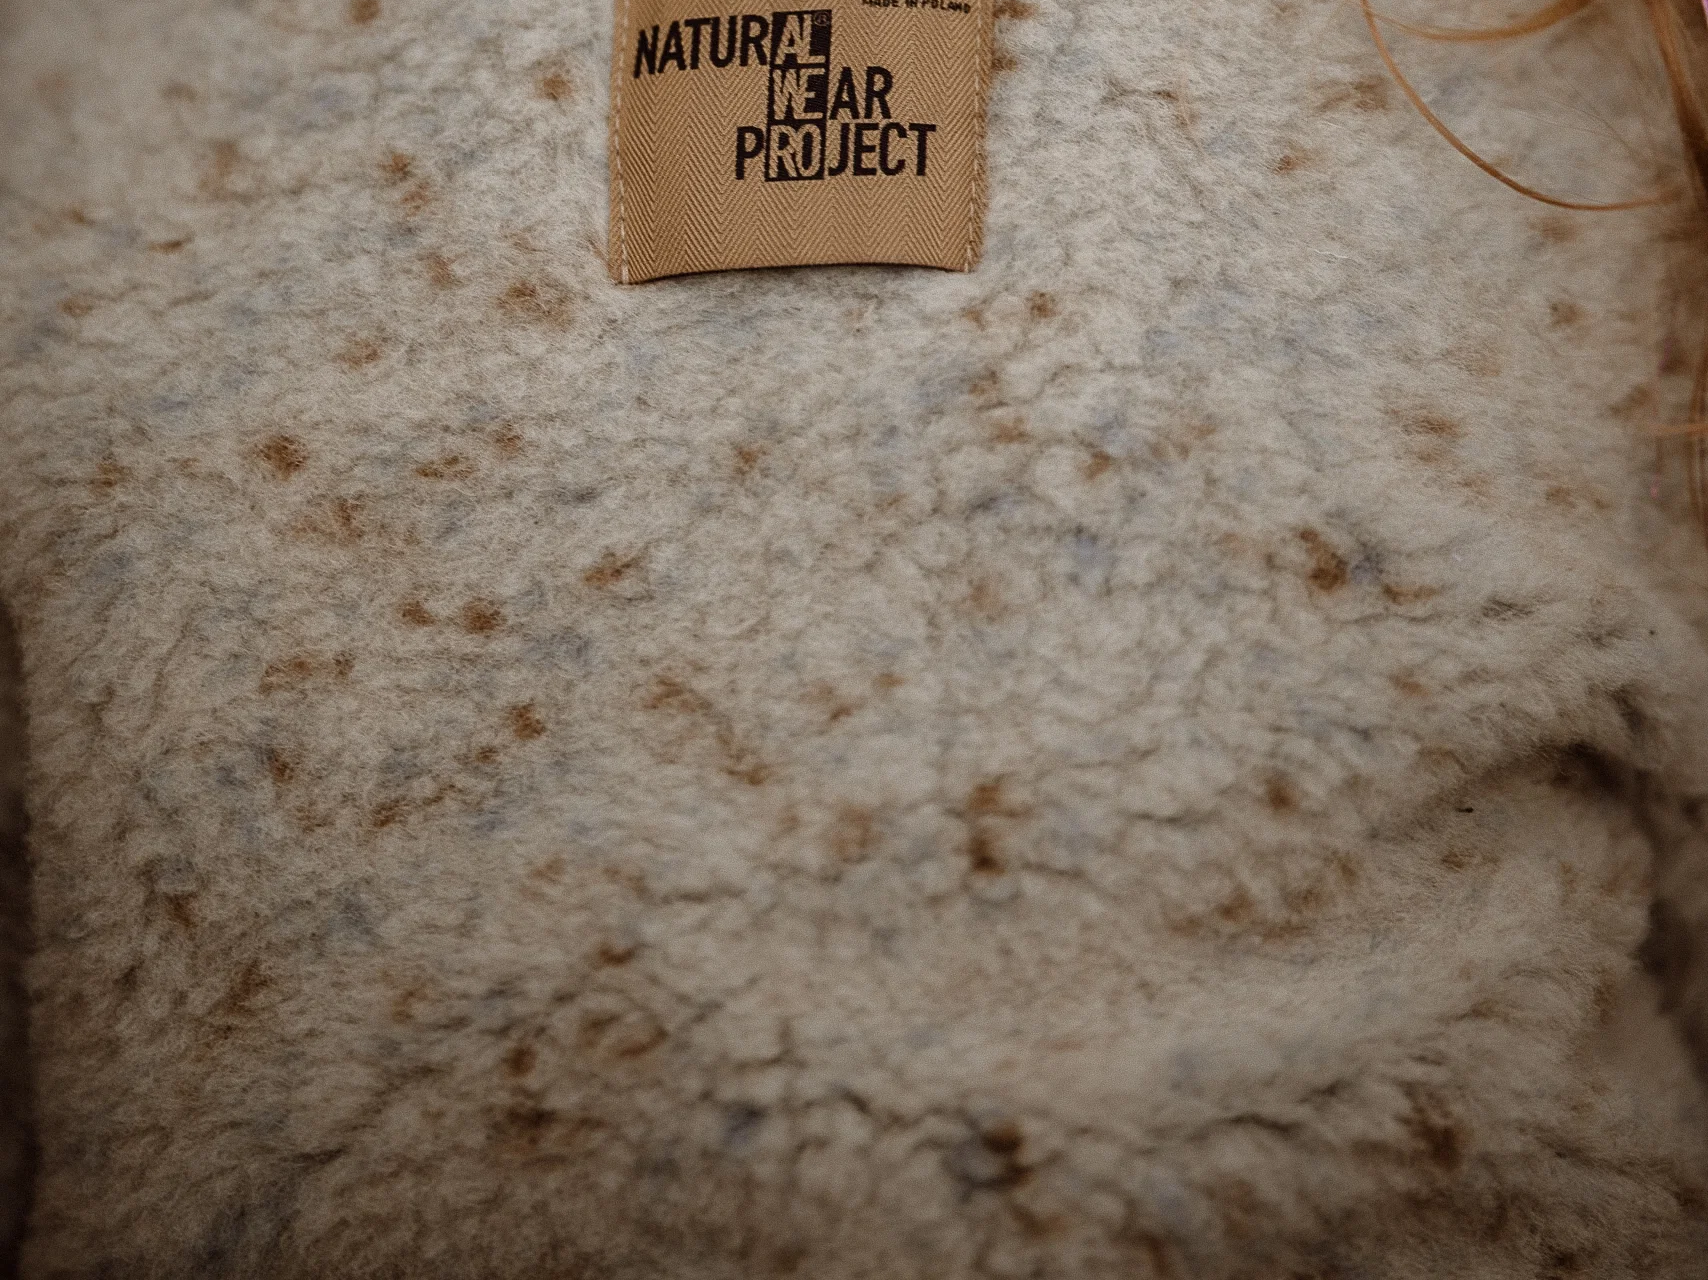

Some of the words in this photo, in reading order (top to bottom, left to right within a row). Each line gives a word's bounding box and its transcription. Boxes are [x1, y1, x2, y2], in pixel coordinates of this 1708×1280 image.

[634, 13, 826, 79] NATURAL
[772, 66, 893, 120] WEAR
[735, 122, 936, 181] PROJECT
